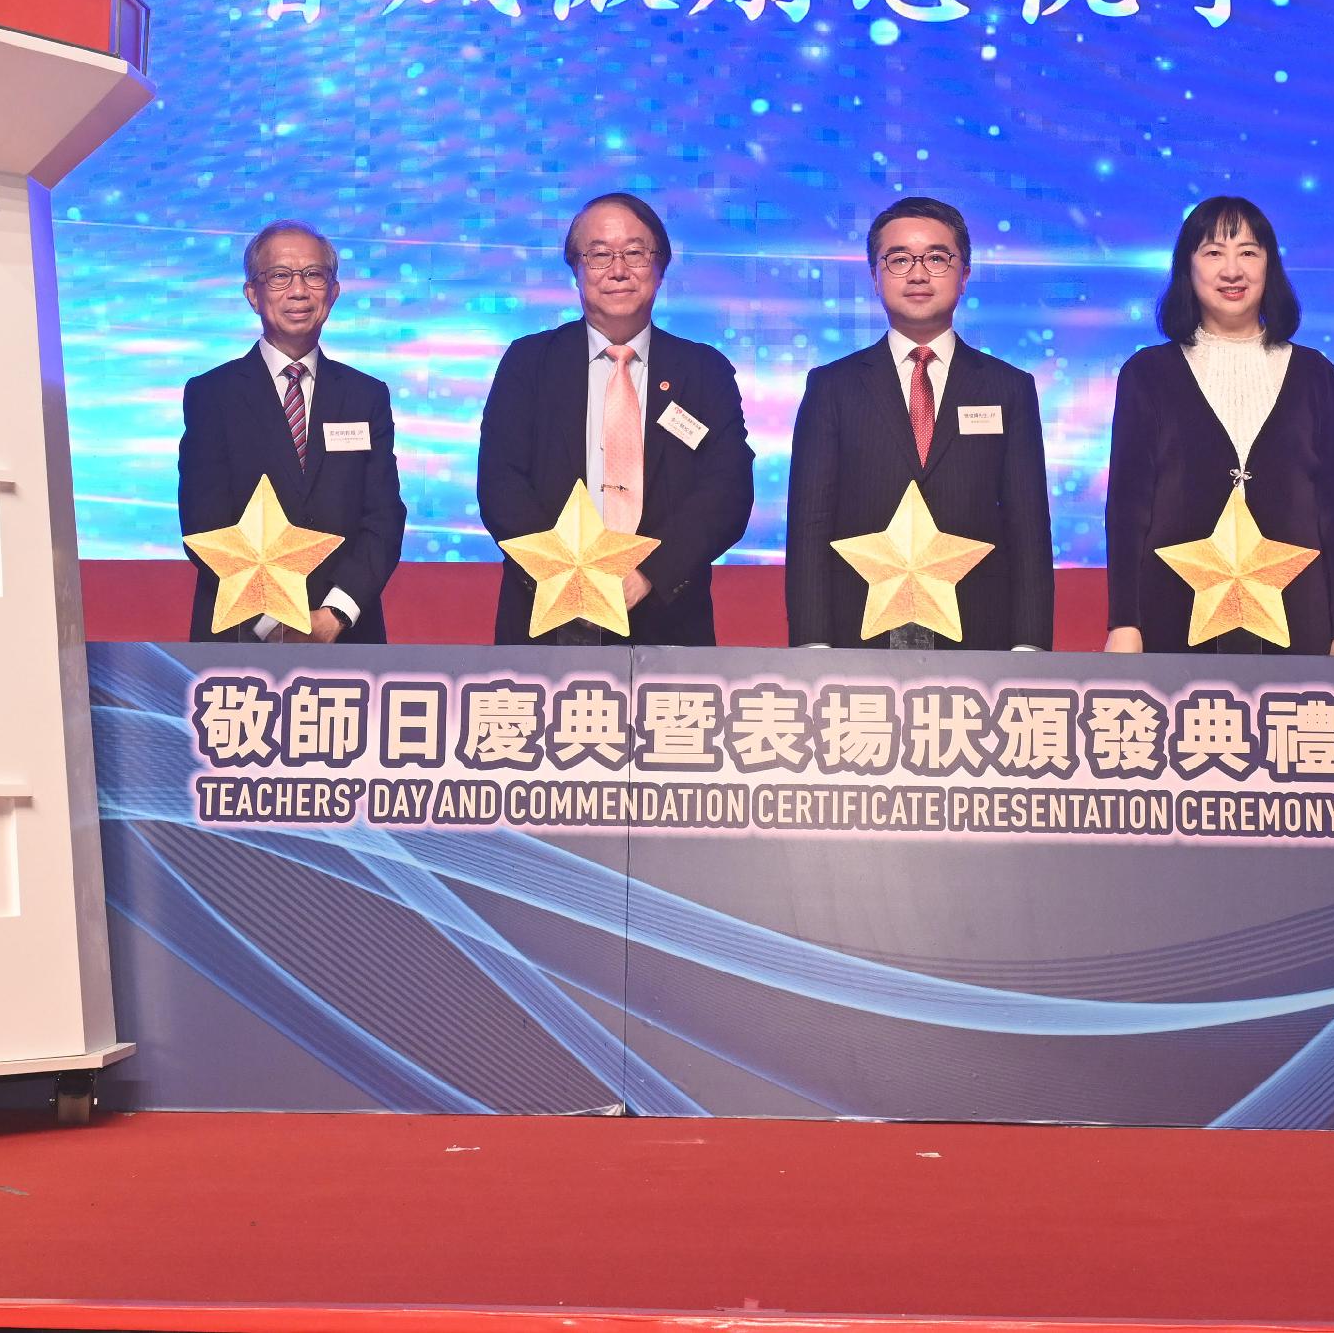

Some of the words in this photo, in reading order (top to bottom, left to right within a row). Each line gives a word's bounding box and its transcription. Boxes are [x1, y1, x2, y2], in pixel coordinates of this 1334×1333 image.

[200, 782, 366, 819] TEACHERS’
[374, 783, 427, 819] DAY
[437, 784, 496, 820] AND
[509, 785, 745, 824] COMMENDATION
[757, 787, 940, 827] CERTIFICATE
[953, 793, 1169, 831] PRESENTATION
